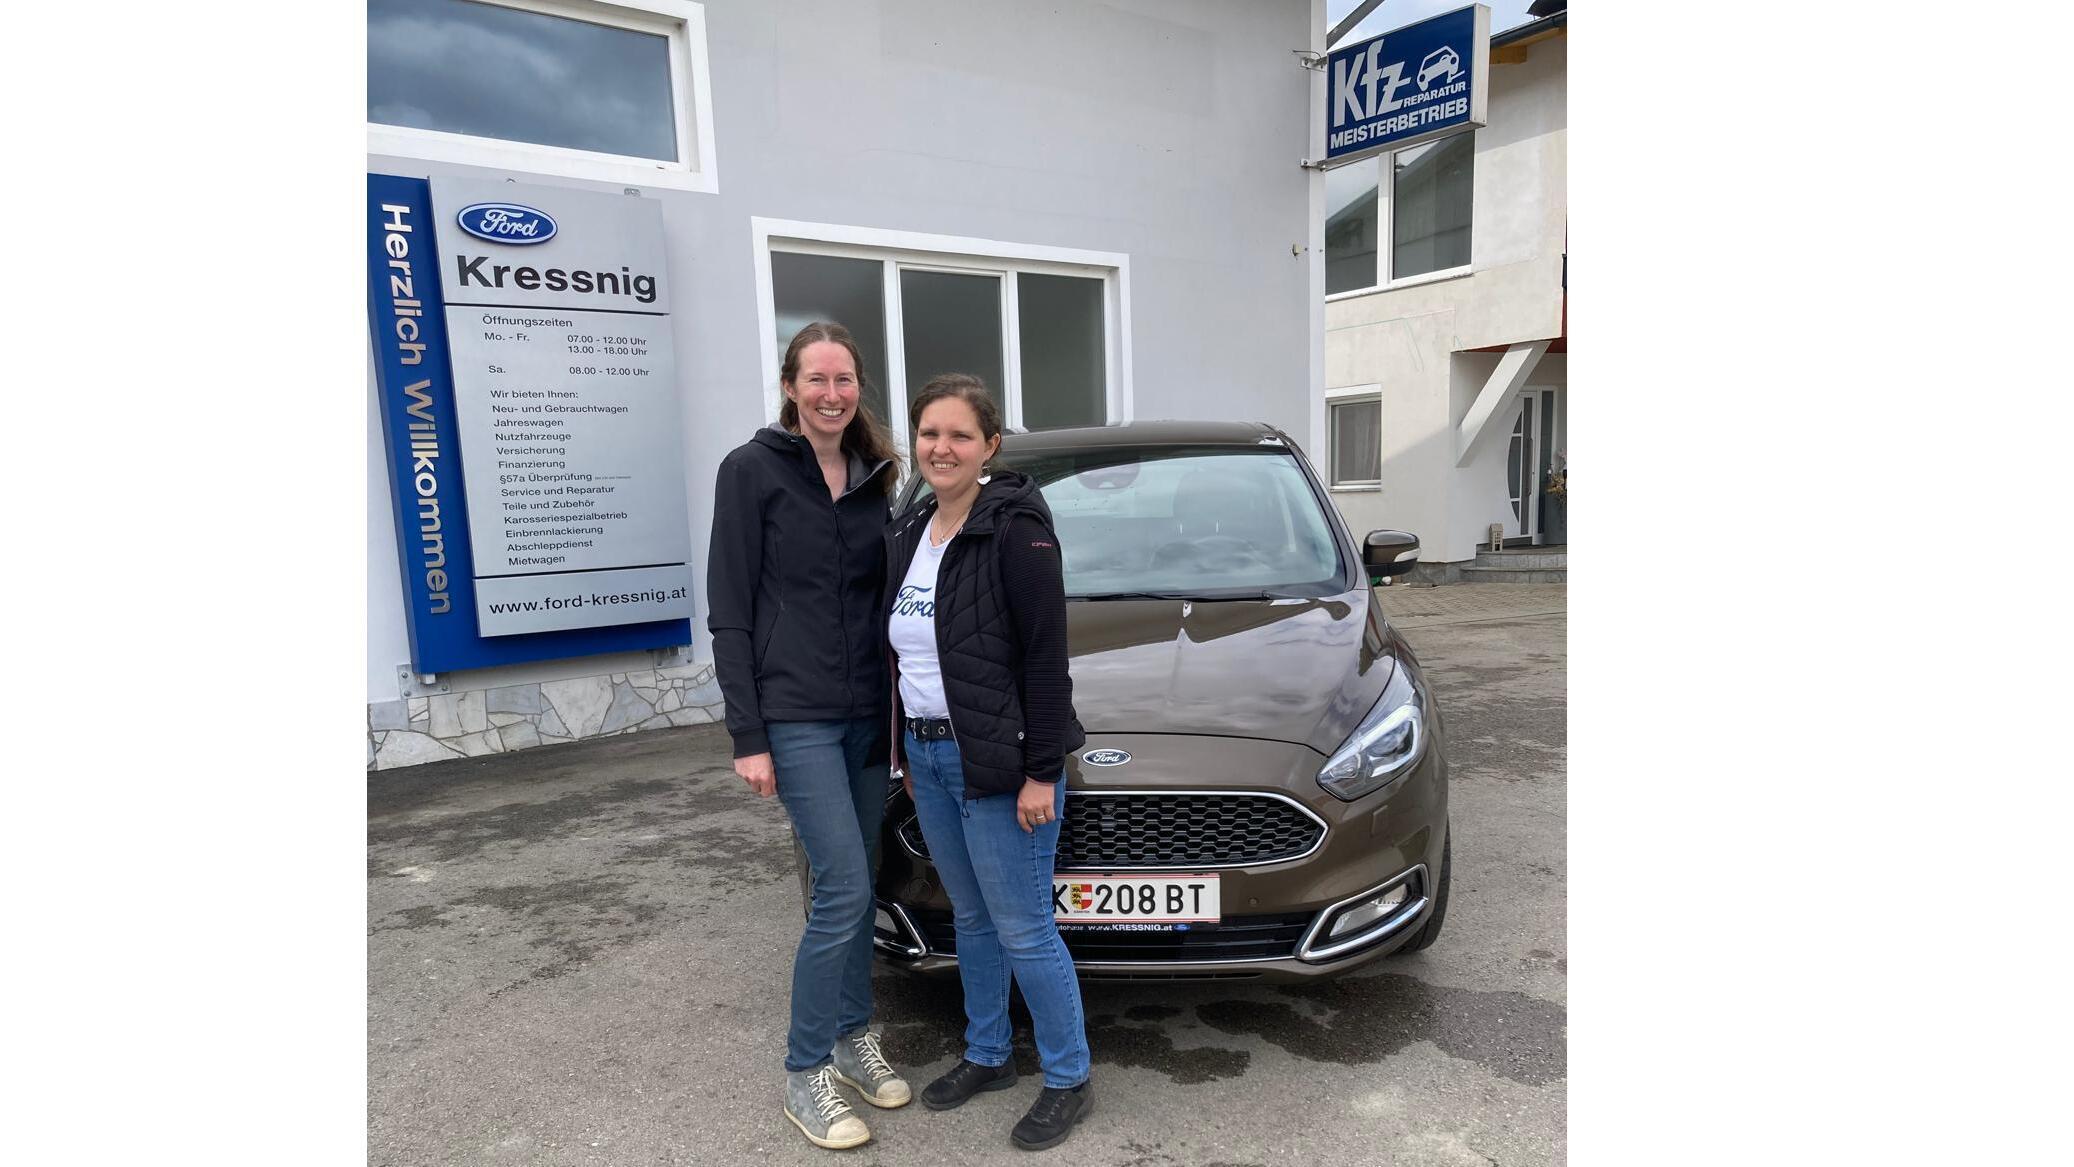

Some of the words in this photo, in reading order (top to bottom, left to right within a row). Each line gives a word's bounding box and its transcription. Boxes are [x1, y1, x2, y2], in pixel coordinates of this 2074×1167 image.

[1333, 39, 1411, 127] Kfz
[1403, 81, 1466, 108] REPARATUR
[1330, 97, 1468, 149] MEISTERBETRIEB
[480, 208, 538, 237] Ford
[382, 203, 428, 365] Herzlich
[457, 255, 657, 303] Kressnig
[482, 315, 573, 328] Öffnungszeiten
[484, 332, 505, 341] Mo.
[516, 333, 530, 341] Fr.
[567, 335, 594, 343] 07.00
[603, 337, 628, 345] 12.00
[630, 337, 647, 346] Uhr
[568, 346, 594, 354] 13.00
[604, 347, 629, 355] 18.00
[631, 348, 648, 356] Uhr
[488, 365, 506, 374] Sa.
[569, 367, 596, 375] 08.00
[605, 368, 631, 376] 12.00
[633, 368, 649, 376] Uhr
[490, 390, 509, 399] Wir
[512, 390, 545, 399] bieten
[547, 390, 579, 399] Ihnen:
[492, 405, 518, 413] Neu-
[521, 405, 542, 413] und
[544, 405, 629, 414] Gebrauchtwagen
[493, 419, 564, 428] Jahreswagen
[495, 433, 572, 442] Nutzfahrzeuge
[496, 446, 566, 455] Versicherung
[498, 460, 566, 469] Finanzierung
[499, 474, 525, 484] §57a
[528, 473, 592, 482] Überprüfung
[404, 379, 451, 614] Willkommen
[501, 489, 541, 497] Service
[544, 487, 563, 495] und
[566, 486, 615, 496] Reparatur
[503, 502, 527, 511] Teile
[530, 501, 550, 510] und
[553, 500, 595, 509] Zubehör
[504, 511, 628, 524] Karosseriespezialbetrieb
[505, 526, 604, 538] Einbrennlackierung
[507, 539, 593, 552] Abschleppdienst
[508, 555, 565, 566] Mietwagen
[489, 586, 687, 614] www.ford-kressnig.at
[1093, 752, 1120, 763] Ford
[1095, 884, 1156, 914] 208
[1166, 884, 1206, 914] BT
